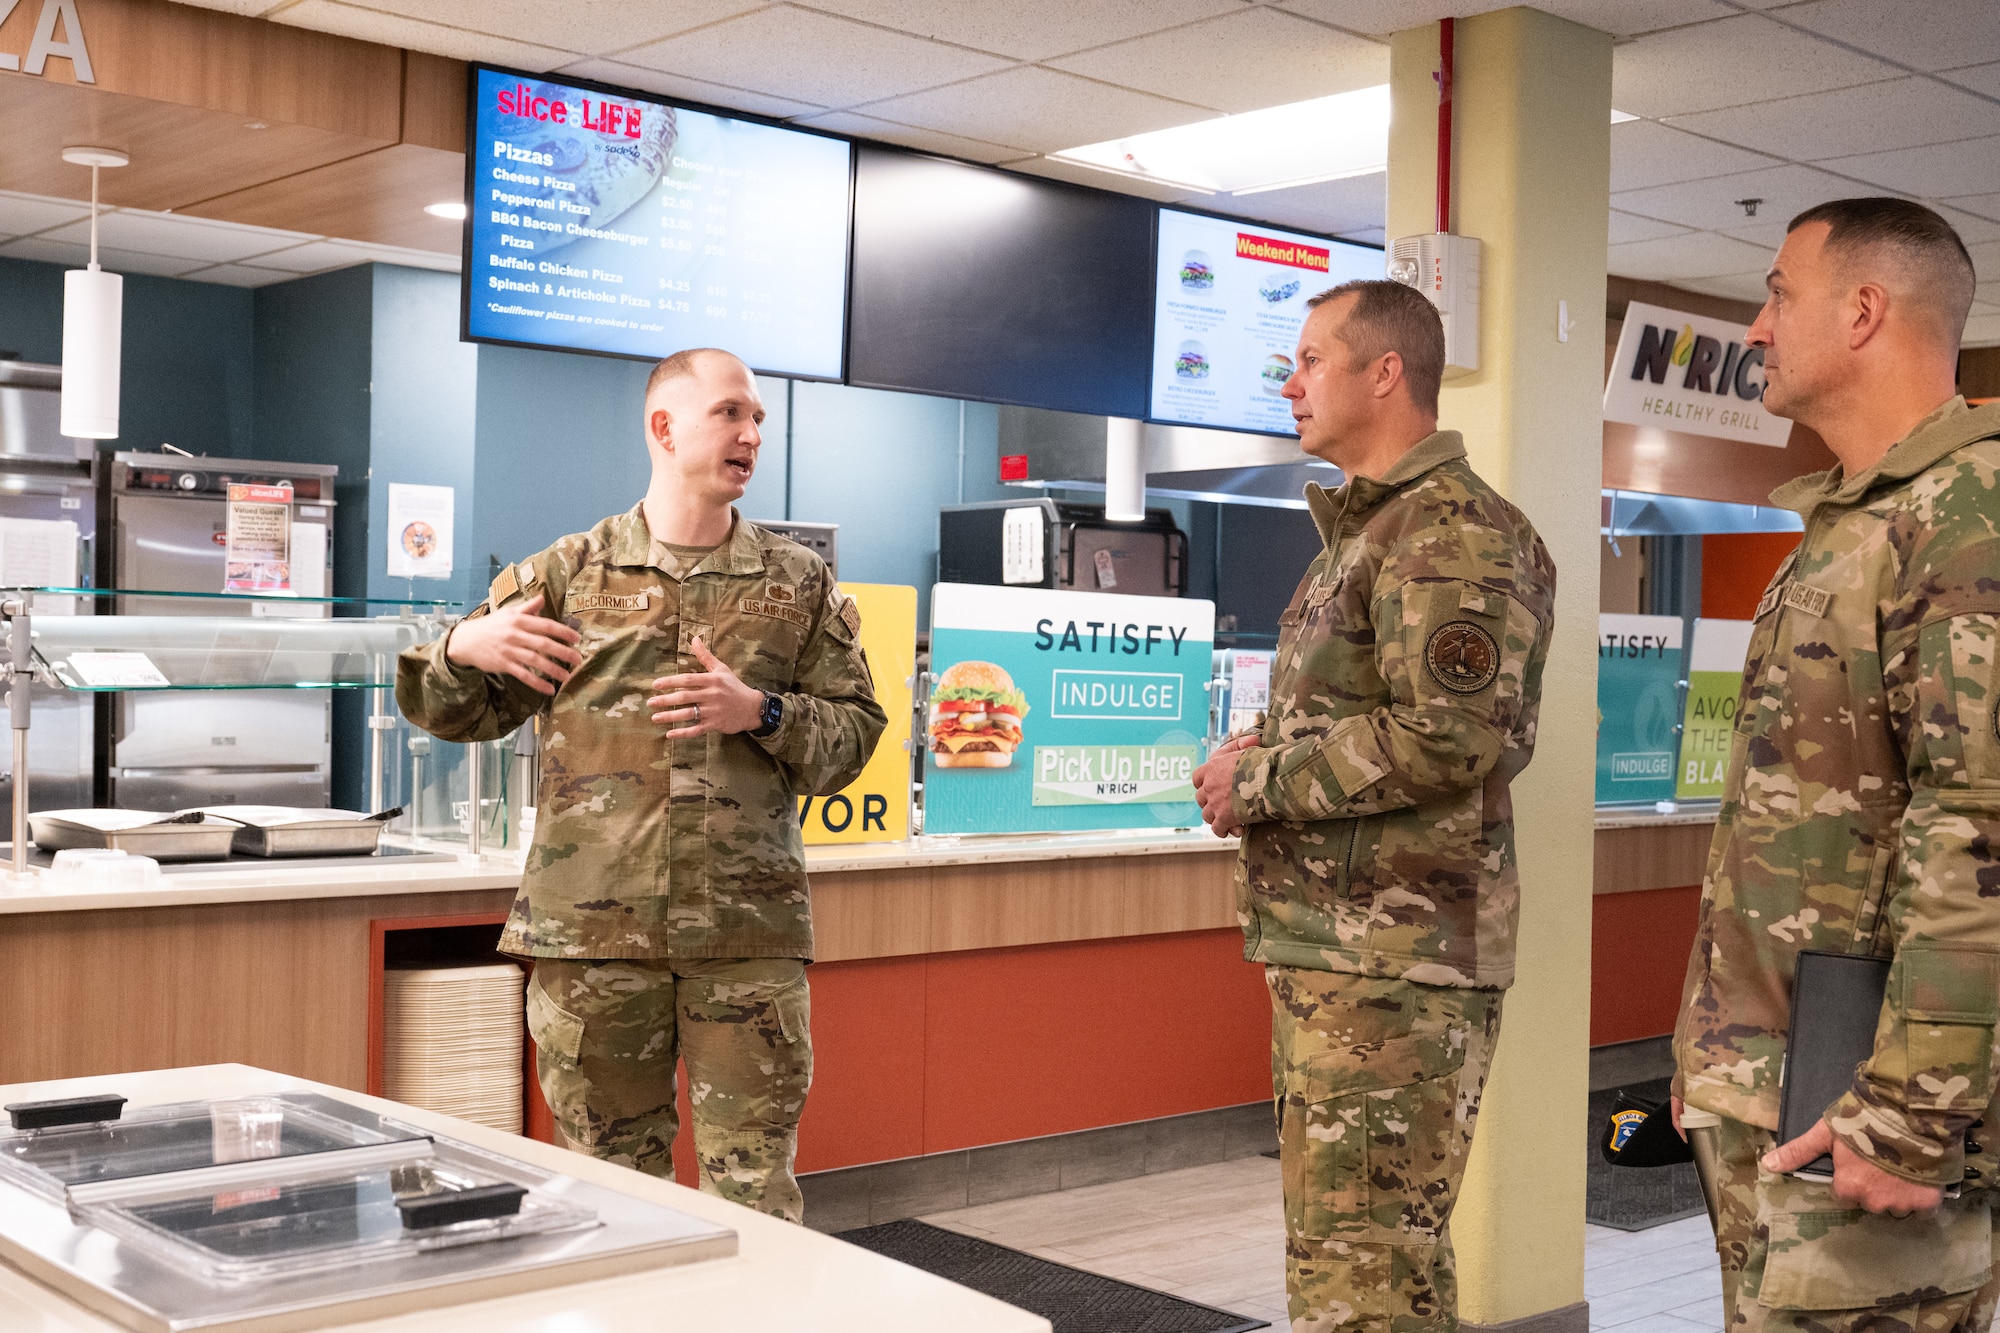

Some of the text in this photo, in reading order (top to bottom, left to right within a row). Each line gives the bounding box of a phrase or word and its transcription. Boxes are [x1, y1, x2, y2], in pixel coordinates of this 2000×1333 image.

[497, 83, 568, 124] slice
[582, 98, 641, 139] LIFE
[493, 140, 554, 167] Pizzas
[605, 144, 641, 158] sodexo
[492, 168, 540, 186] Cheese
[543, 175, 576, 192] Pizza
[662, 176, 703, 192] Regular
[491, 189, 555, 211] Pepperoni
[559, 200, 591, 216] Pizza
[491, 211, 519, 227] BBQ
[523, 216, 562, 233] Bacon
[566, 223, 650, 246] Cheeseburger
[501, 234, 535, 250] Pizza
[1237, 237, 1329, 269] Weekend Menu
[489, 254, 536, 272] Buffalo
[539, 261, 588, 279] Chicken
[592, 268, 623, 284] Pizza
[658, 278, 690, 292] $4.25
[488, 276, 540, 294] Spinach
[544, 283, 554, 295] &
[557, 285, 617, 304] Artichoke
[620, 294, 651, 308] Pizza
[658, 298, 690, 313] $4.75
[546, 311, 575, 323] pizzas
[577, 315, 592, 324] are
[594, 317, 627, 328] cooked
[629, 320, 638, 329] to
[640, 322, 664, 332] order
[1642, 397, 1759, 431] HEALTHY GRILL
[575, 594, 640, 610] McCORMICK
[763, 603, 780, 617] AIR
[782, 607, 810, 628] FORCE
[1034, 619, 1187, 656] SATISFY
[1061, 681, 1174, 708] INDULGE
[1691, 728, 1728, 752] THE
[1041, 748, 1191, 782] Pick Up Here
[1616, 758, 1668, 775] INDULGE
[1097, 783, 1137, 795] N'RICH
